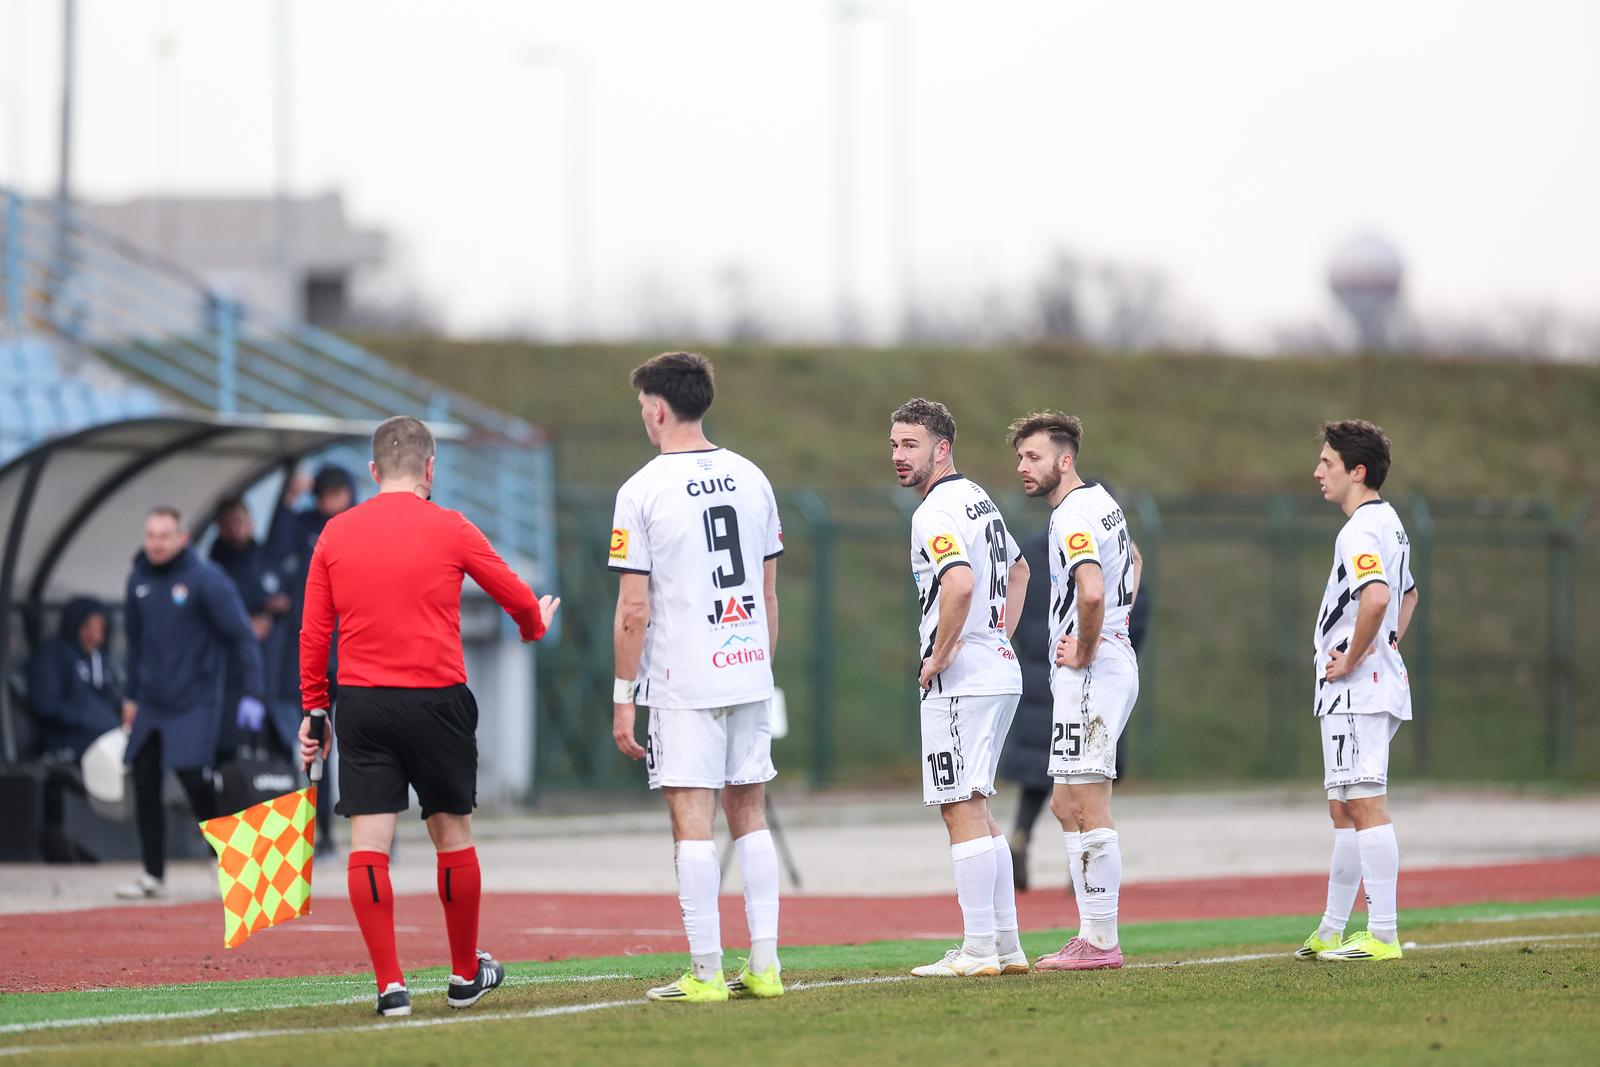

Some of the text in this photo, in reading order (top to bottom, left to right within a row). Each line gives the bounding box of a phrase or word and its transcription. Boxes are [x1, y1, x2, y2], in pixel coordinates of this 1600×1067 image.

[686, 474, 736, 497] ČUIĆ
[703, 504, 746, 589] 9
[1116, 528, 1134, 607] 2
[712, 648, 765, 669] Cetina
[1052, 722, 1081, 756] 25
[1332, 734, 1345, 767] 7
[927, 751, 955, 787] 19
